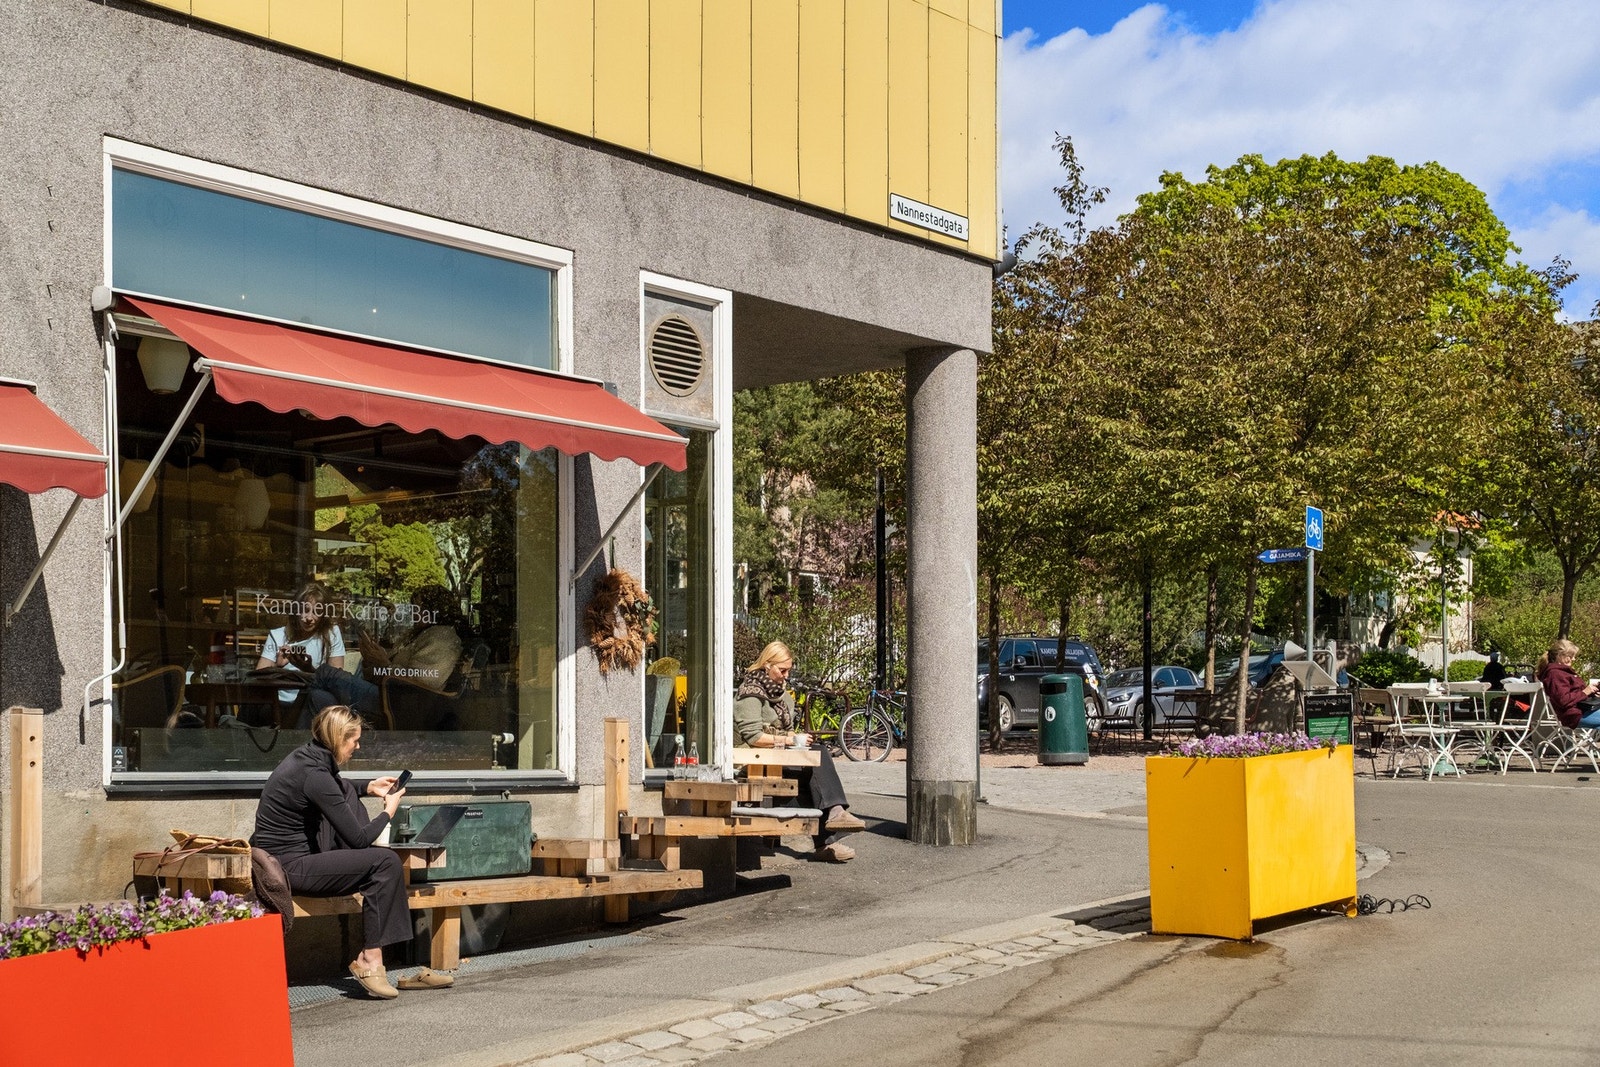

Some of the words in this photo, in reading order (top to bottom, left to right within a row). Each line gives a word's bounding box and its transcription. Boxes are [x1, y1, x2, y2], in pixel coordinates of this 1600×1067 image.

[897, 201, 963, 233] Nannestadgata
[255, 593, 337, 621] Kampen
[342, 600, 388, 621] Kaffe
[410, 604, 440, 624] Bar
[373, 667, 391, 676] MAT
[394, 668, 407, 677] OG
[408, 668, 440, 678] DRIKKE
